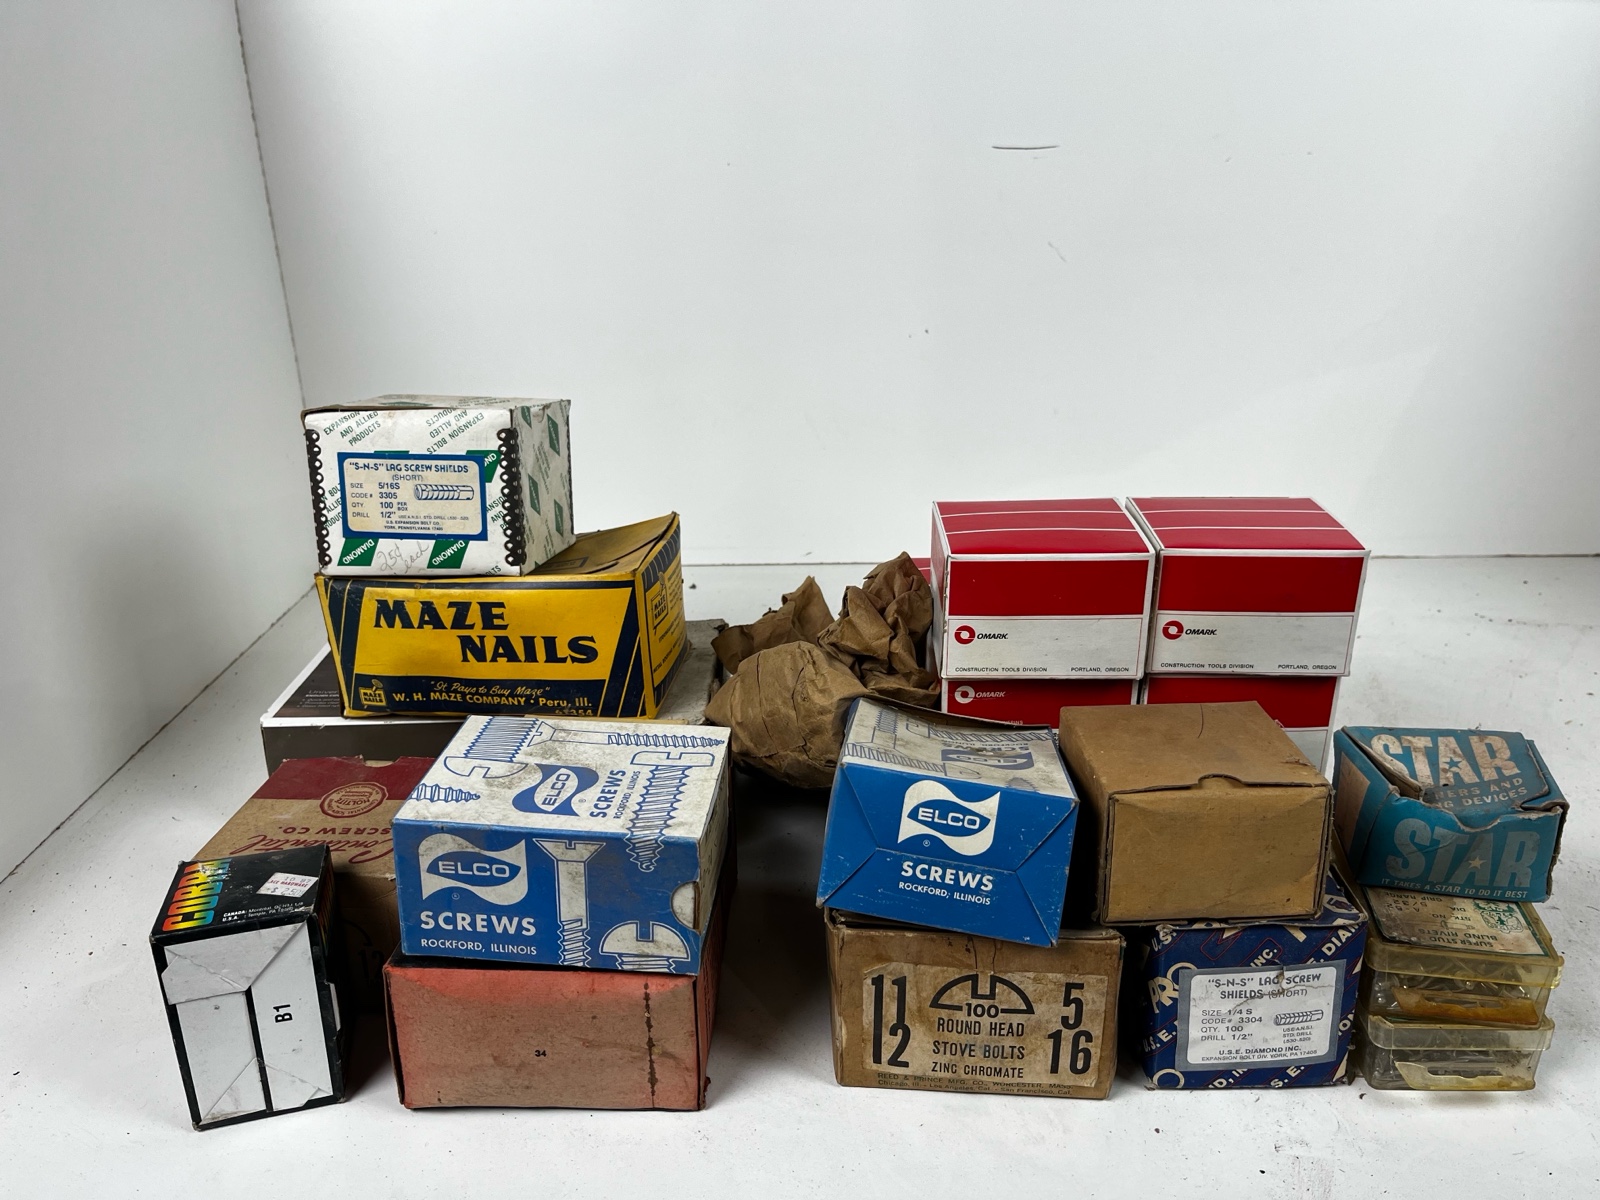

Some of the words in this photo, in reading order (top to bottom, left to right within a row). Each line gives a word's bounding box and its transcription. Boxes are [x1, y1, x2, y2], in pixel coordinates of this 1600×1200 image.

[453, 409, 469, 422] AND
[340, 425, 355, 439] AND
[355, 410, 379, 429] ALLIED
[429, 421, 452, 439] ALLIED
[449, 412, 485, 440] EXPANSION
[348, 420, 382, 447] PRODUCTS
[426, 436, 449, 455] BOLTS
[386, 464, 403, 472] LAG
[404, 464, 433, 472] SCREW
[434, 464, 469, 473] SHIELDS
[378, 482, 401, 490] 5/16S
[392, 474, 424, 482] (SHORT)
[378, 492, 398, 500] 3305
[342, 538, 375, 565] DIAMOND
[431, 539, 466, 566] DIAMOND
[373, 598, 510, 631] MAZE
[977, 632, 1009, 640] OMARK
[1184, 628, 1218, 636] OMARK
[456, 633, 600, 665] NAILS
[450, 682, 477, 695] Pays
[478, 685, 488, 694] to
[489, 685, 512, 696] Buy
[392, 692, 410, 702] W.
[412, 692, 427, 702] H.
[430, 692, 464, 702] MAZE
[466, 694, 526, 706] COMPANY
[538, 697, 572, 708] Peru,
[575, 696, 593, 707] Ill.
[1369, 733, 1522, 787] STAR
[626, 770, 641, 791] ILLINOIS
[1489, 777, 1524, 793] AND
[541, 773, 571, 806] ELCO
[589, 769, 627, 819] SCREWS
[1461, 786, 1528, 807] DEVICES
[917, 807, 981, 830] ELCO
[278, 826, 310, 835] CO.
[315, 827, 392, 835] SCREW
[1385, 817, 1542, 889] STAR
[438, 860, 511, 878] ELCO
[900, 860, 994, 892] SCREWS
[280, 880, 309, 888] HARDWARE
[1381, 877, 1391, 885] IT
[1393, 879, 1422, 889] TAKES
[1433, 884, 1462, 894] STAR
[1464, 887, 1476, 895] TO
[1478, 888, 1491, 896] DO
[1493, 889, 1503, 897] IT
[1504, 890, 1529, 899] BEST
[898, 881, 951, 899] ROCKFORD,
[953, 891, 992, 906] ILLINOIS
[1420, 893, 1443, 903] GRIP
[420, 910, 537, 937] SCREWS
[1418, 928, 1459, 938] RIVETS
[1429, 936, 1458, 945] STUD
[1463, 932, 1499, 942] BLIND
[421, 938, 486, 953] ROCKFORD,
[490, 943, 538, 956] ILLINOIS
[1459, 938, 1494, 948] SUPER
[1208, 977, 1254, 988] "S-N-S"
[1258, 976, 1280, 986] LAG
[1285, 973, 1322, 985] SCREW
[1220, 989, 1264, 1000] SHIELDS
[1268, 988, 1308, 1000] (SHORT)
[272, 1004, 293, 1024] B1
[965, 1002, 1000, 1019] 100
[1201, 1009, 1222, 1017] SIZE
[1227, 1008, 1243, 1016] 1/4
[937, 1017, 982, 1036] ROUND
[989, 1021, 1025, 1038] HEAD
[1238, 1016, 1263, 1024] 3304
[1231, 1033, 1253, 1041] 1/2"
[534, 1049, 548, 1058] 34
[932, 1040, 977, 1058] STOVE
[982, 1043, 1026, 1060] BOLTS
[1047, 1029, 1094, 1076] 16
[1245, 1046, 1284, 1054] DIAMOND
[877, 1072, 899, 1080] REED
[931, 1061, 958, 1075] ZINC
[963, 1064, 1025, 1079] CHROMATE
